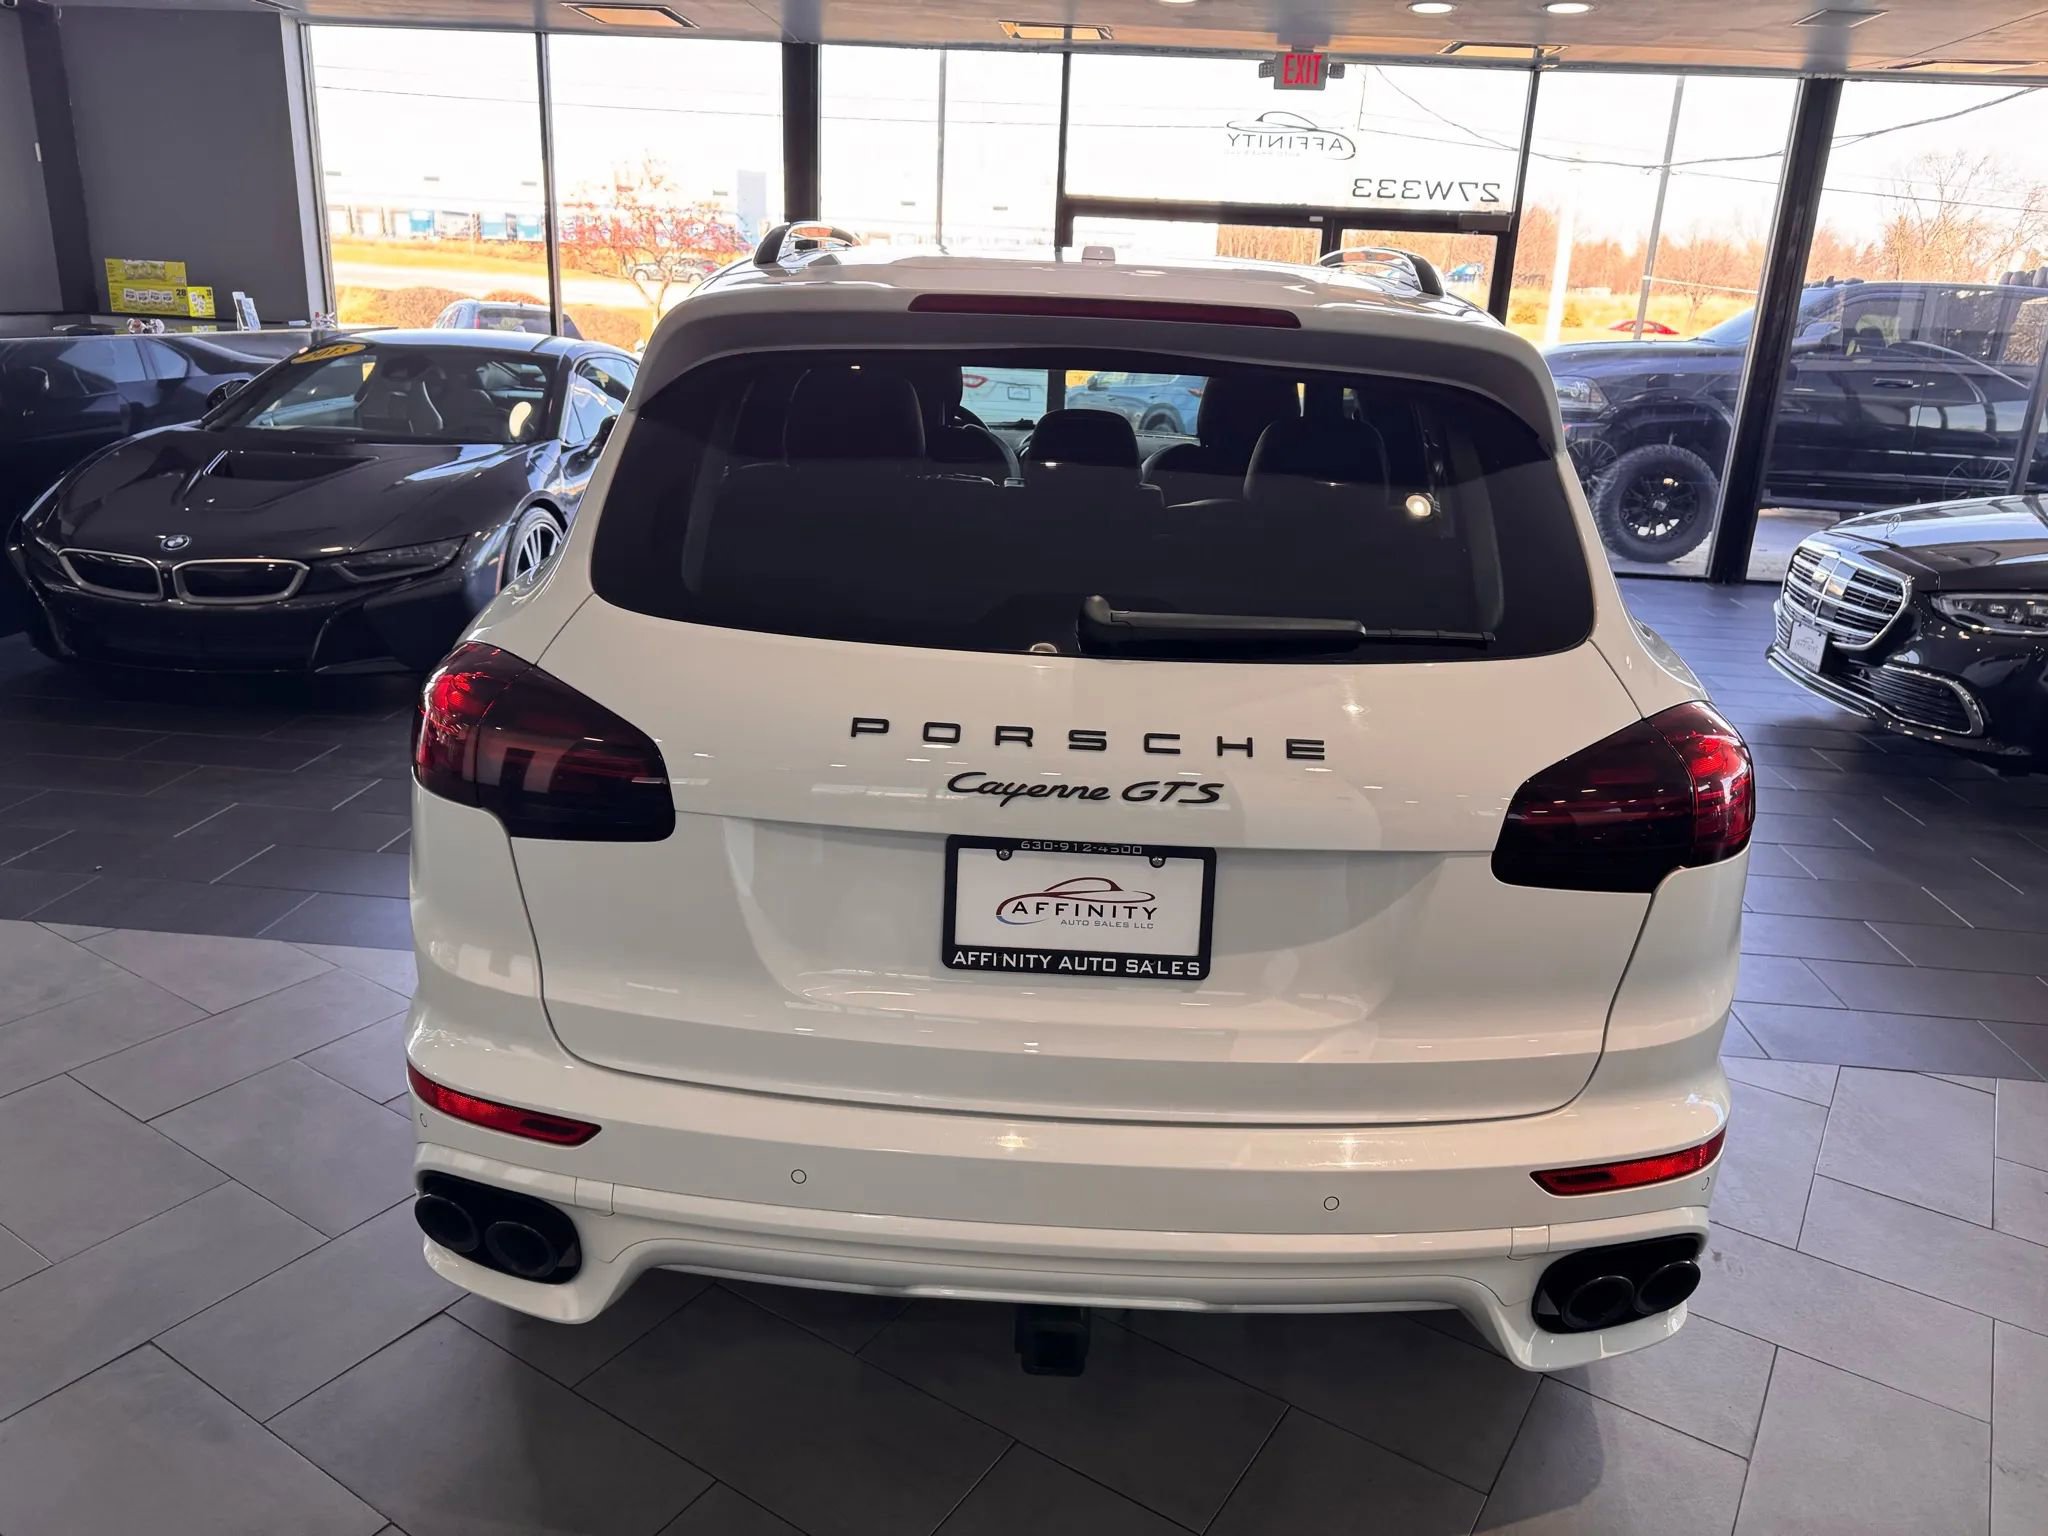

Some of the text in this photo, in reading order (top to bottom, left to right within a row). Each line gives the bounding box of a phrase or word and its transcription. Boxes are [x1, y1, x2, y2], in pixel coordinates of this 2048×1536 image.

[1283, 53, 1322, 85] EXIT
[850, 717, 1325, 760] PORSCHE
[946, 771, 1225, 807] Cayenne GTS
[1011, 901, 1158, 920] AFFINITY
[1060, 918, 1154, 930] AUTO SALES LLC
[952, 950, 1200, 976] AFFINITY AUTO SALES
